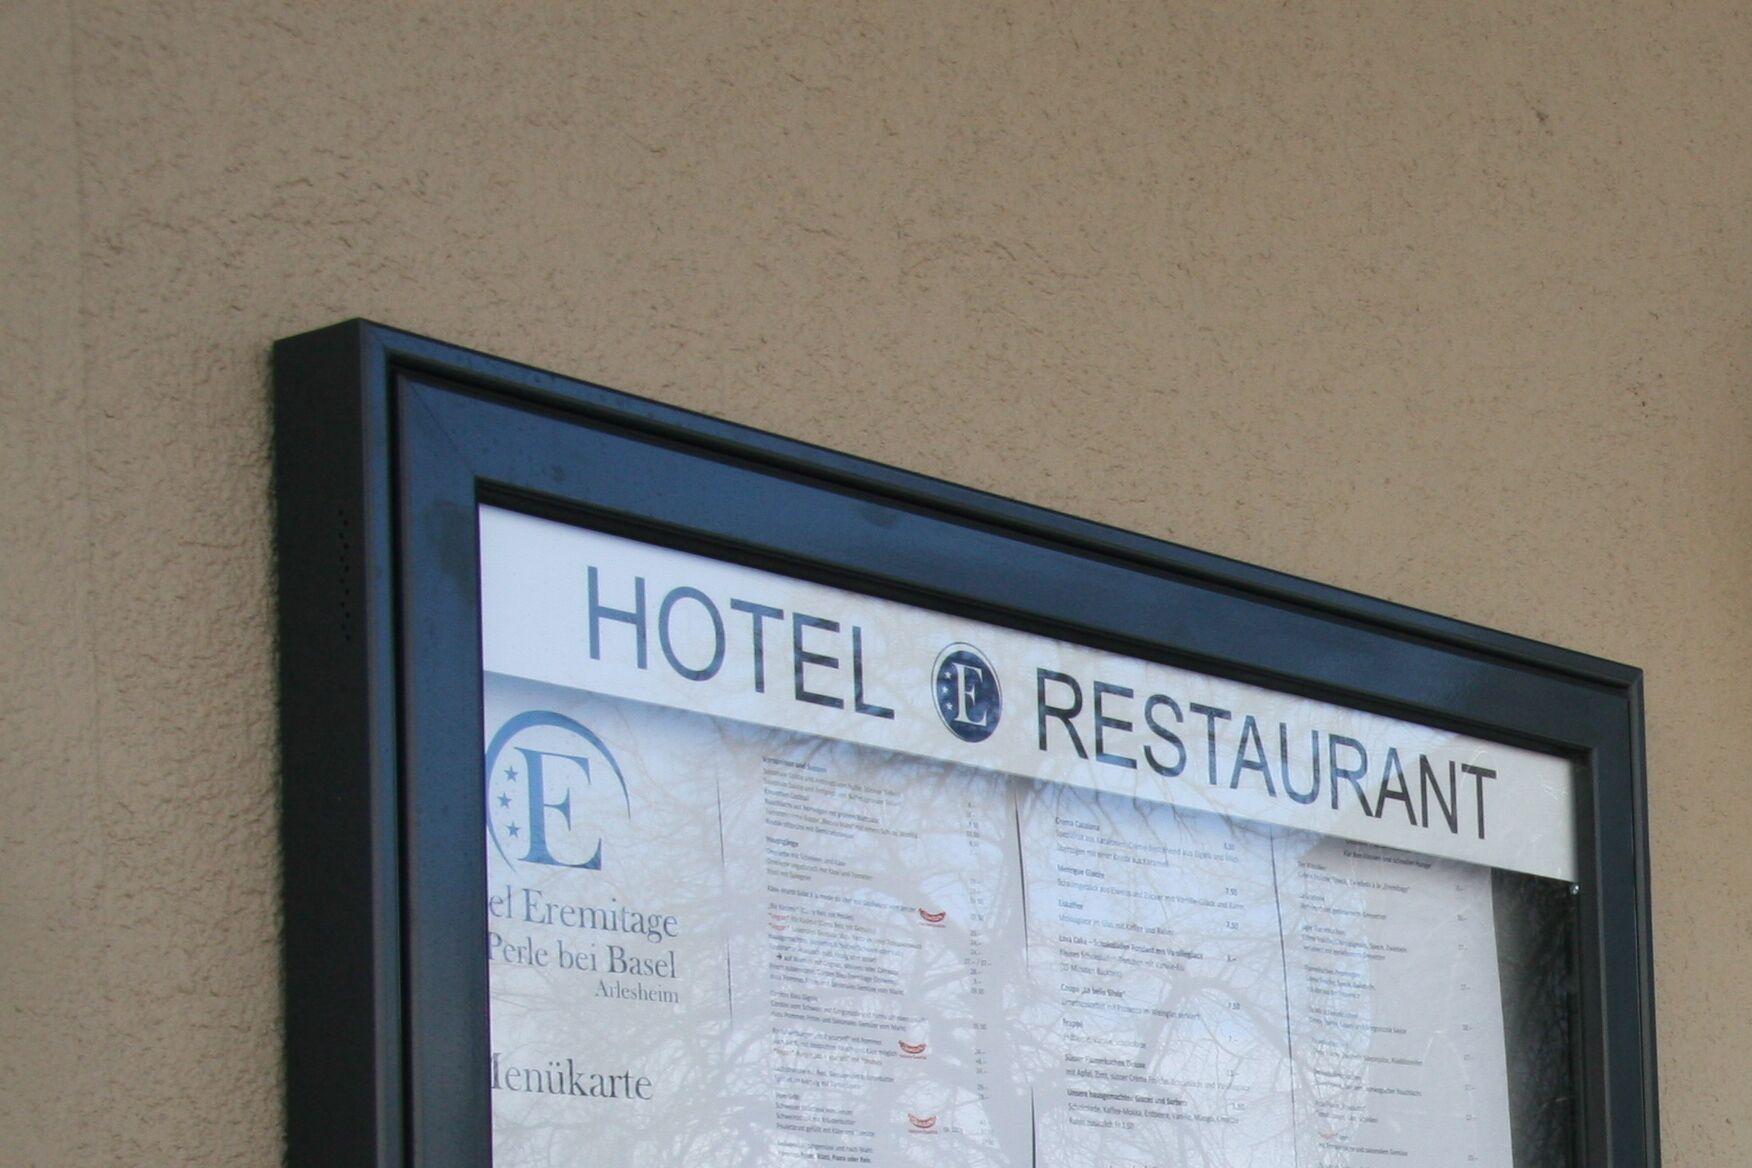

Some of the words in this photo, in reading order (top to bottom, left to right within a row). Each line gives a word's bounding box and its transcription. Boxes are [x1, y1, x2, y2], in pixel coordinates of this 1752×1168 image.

[586, 565, 895, 720] HOTEL
[1036, 667, 1497, 839] RESTAURANT
[514, 746, 603, 871] E
[521, 888, 679, 943] Eremitage
[488, 931, 548, 968] Perle
[557, 940, 598, 971] bei
[606, 944, 678, 979] Basel
[594, 979, 679, 1004] Arlesheim
